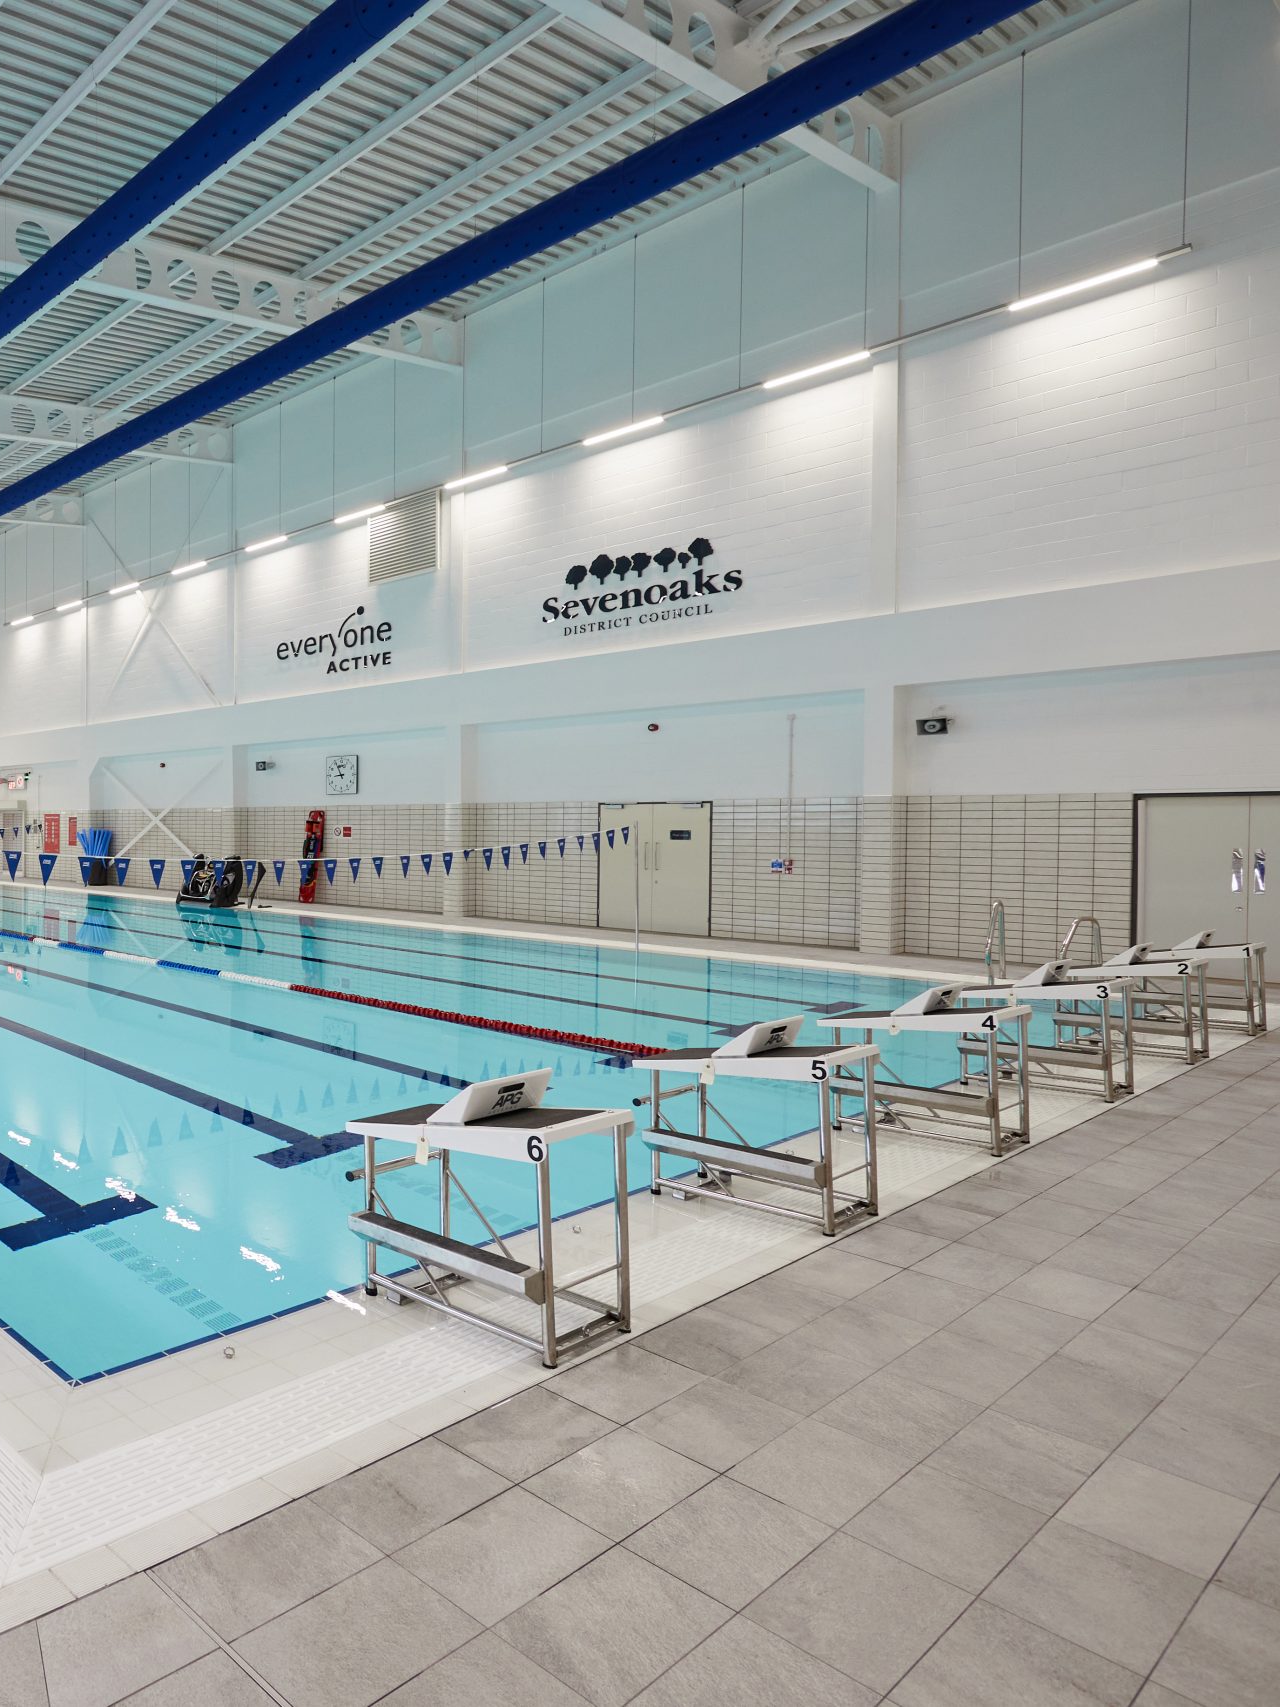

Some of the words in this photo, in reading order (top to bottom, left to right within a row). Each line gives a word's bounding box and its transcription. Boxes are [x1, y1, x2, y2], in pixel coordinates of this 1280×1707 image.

[542, 569, 744, 623] Sevenoaks
[563, 616, 633, 637] DISTRICT
[638, 603, 713, 625] COUNCIL
[276, 605, 392, 661] everyone
[326, 651, 392, 674] ACTIVE
[1242, 946, 1251, 957] 1
[1177, 963, 1189, 975] 2
[1096, 985, 1109, 999] 3
[981, 1014, 997, 1031] 4
[811, 1059, 827, 1081] 5
[491, 1091, 523, 1110] APG
[526, 1135, 544, 1162] 6
